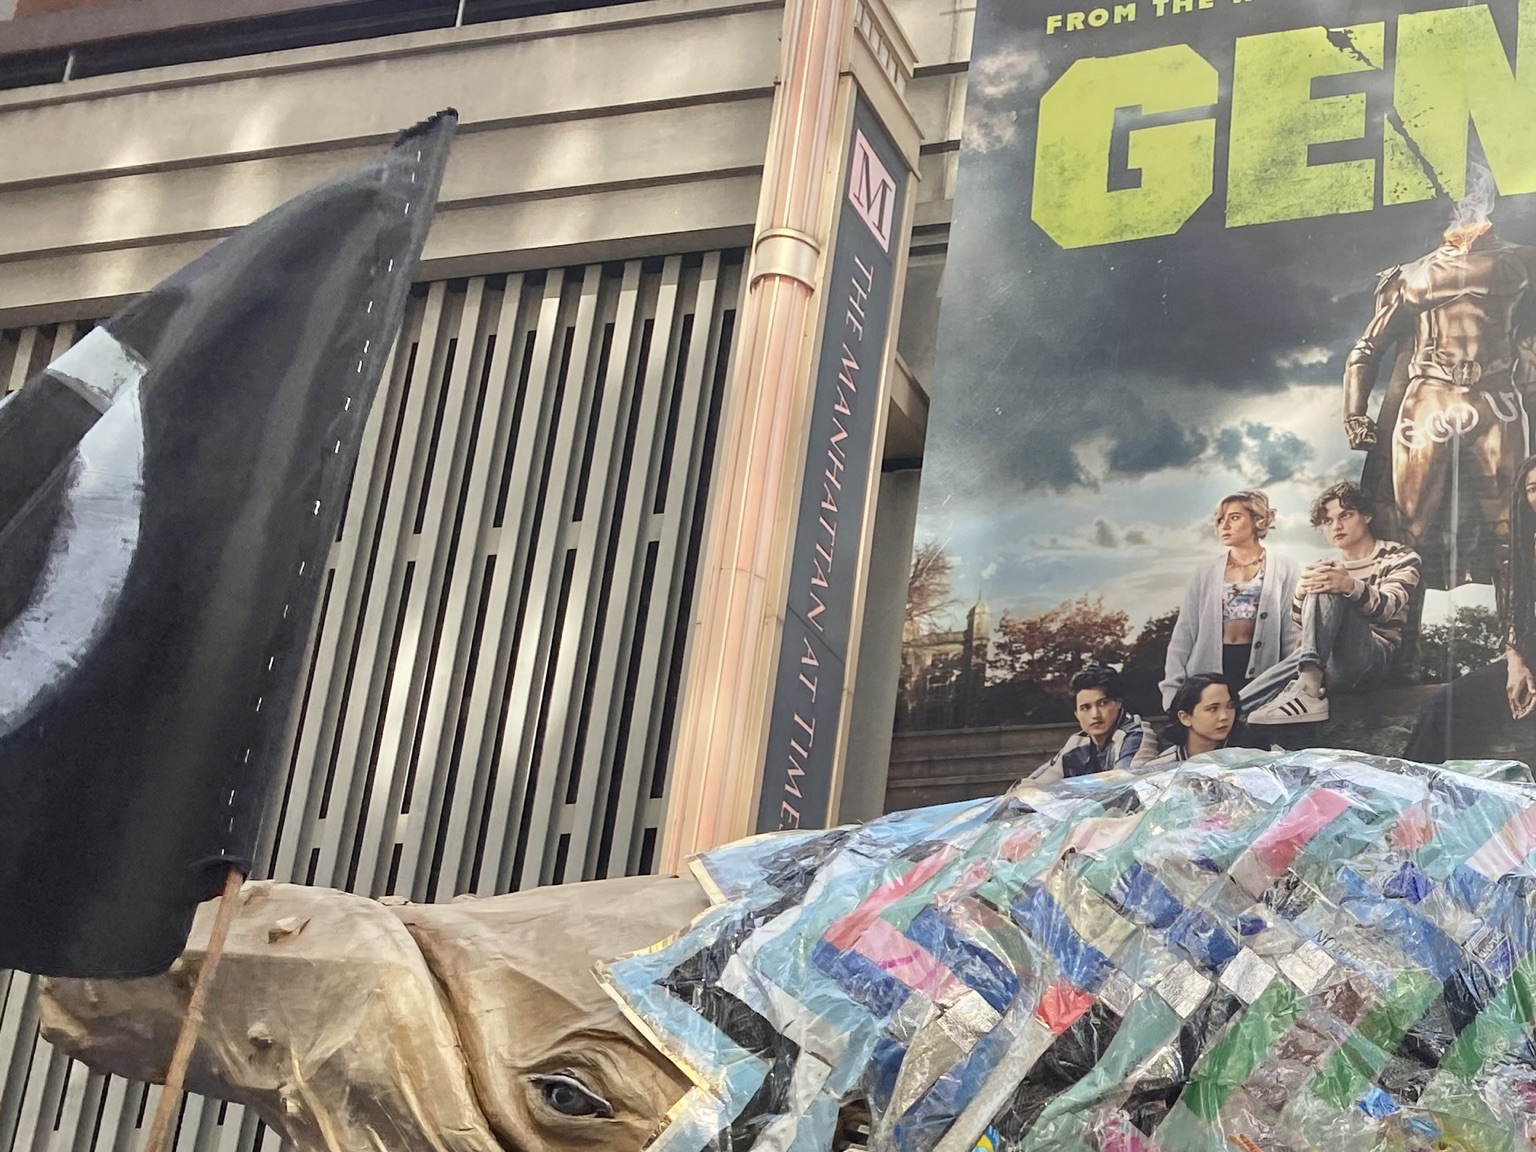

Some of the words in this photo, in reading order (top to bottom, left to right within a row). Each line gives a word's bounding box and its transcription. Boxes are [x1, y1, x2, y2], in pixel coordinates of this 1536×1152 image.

[1046, 3, 1136, 35] FROM
[843, 252, 874, 340] THE
[805, 339, 863, 633] MANHATTAN
[794, 636, 820, 702] AT
[779, 708, 816, 830] TIME
